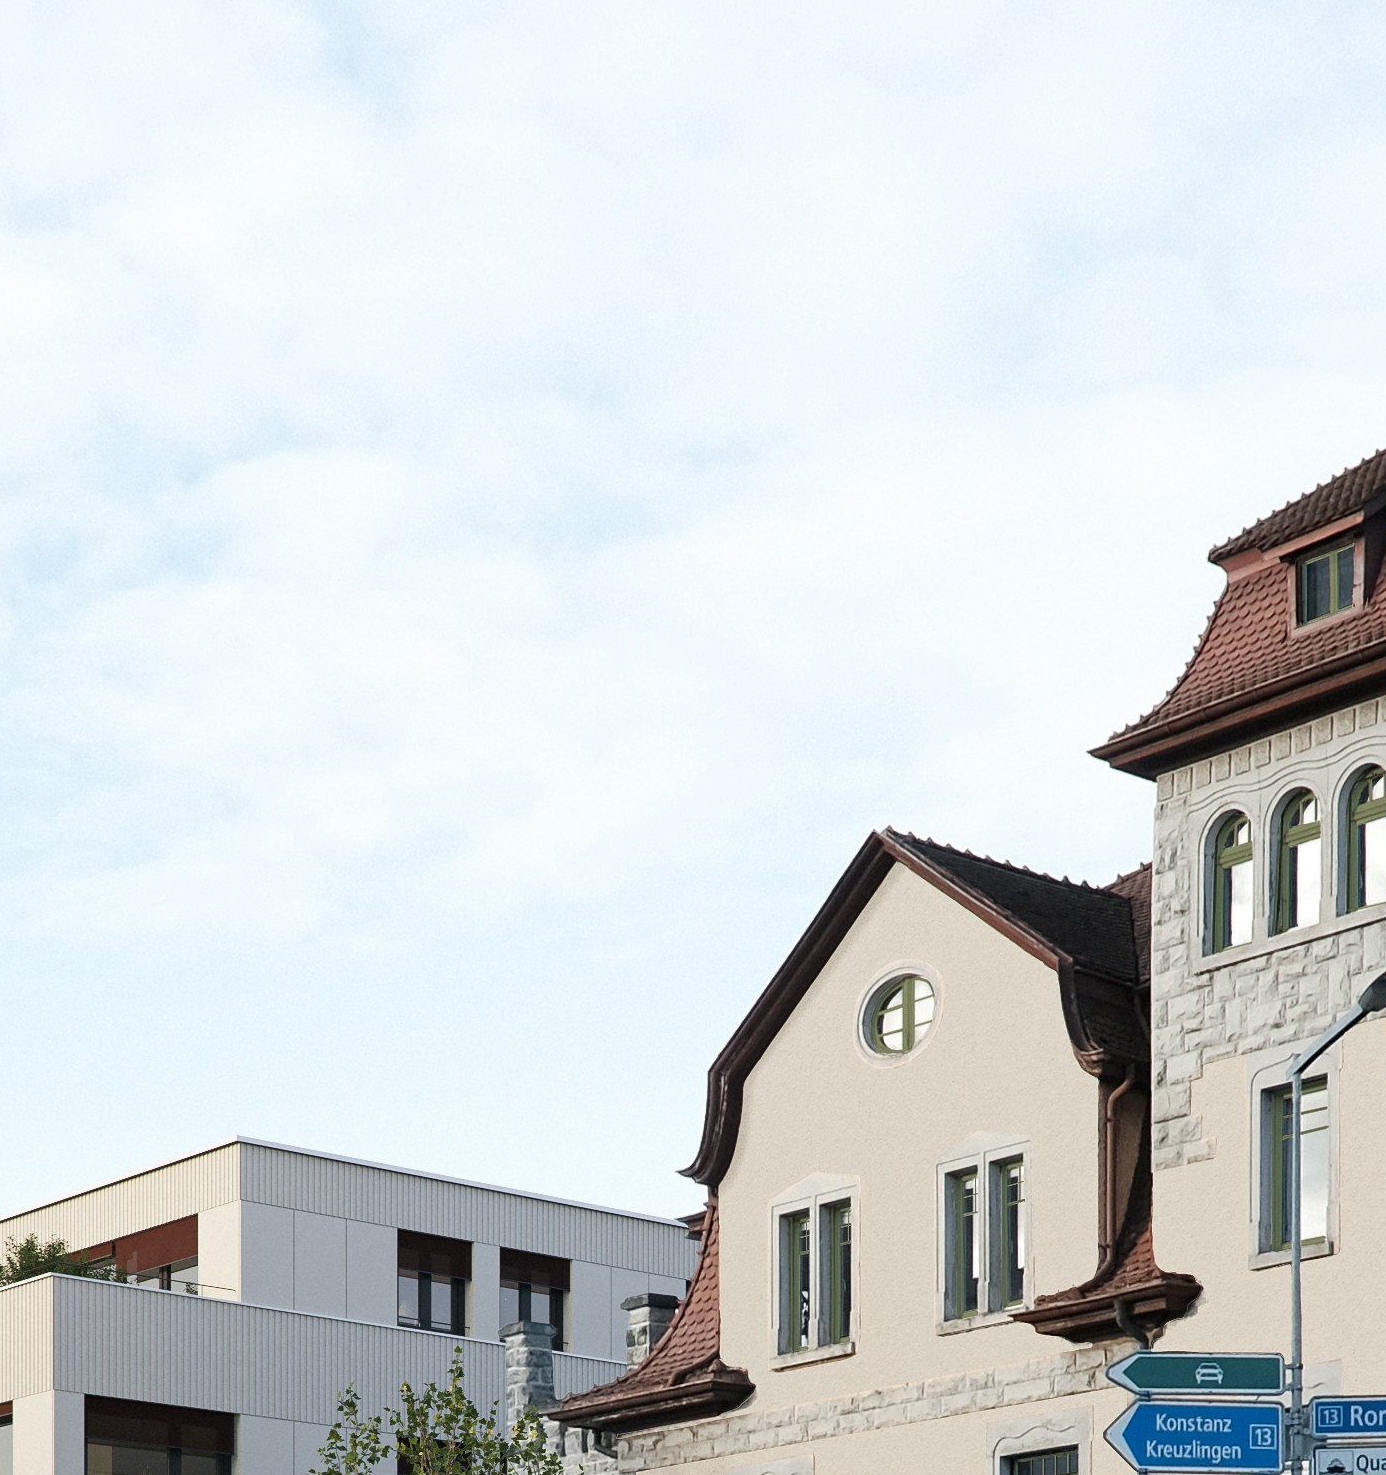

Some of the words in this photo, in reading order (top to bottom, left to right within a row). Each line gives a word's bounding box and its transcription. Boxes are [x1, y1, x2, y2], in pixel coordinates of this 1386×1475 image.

[1156, 1413, 1232, 1433] Konstanz
[1323, 1409, 1339, 1424] 13
[1254, 1428, 1272, 1446] 13
[1146, 1440, 1242, 1463] Kreuzlingen
